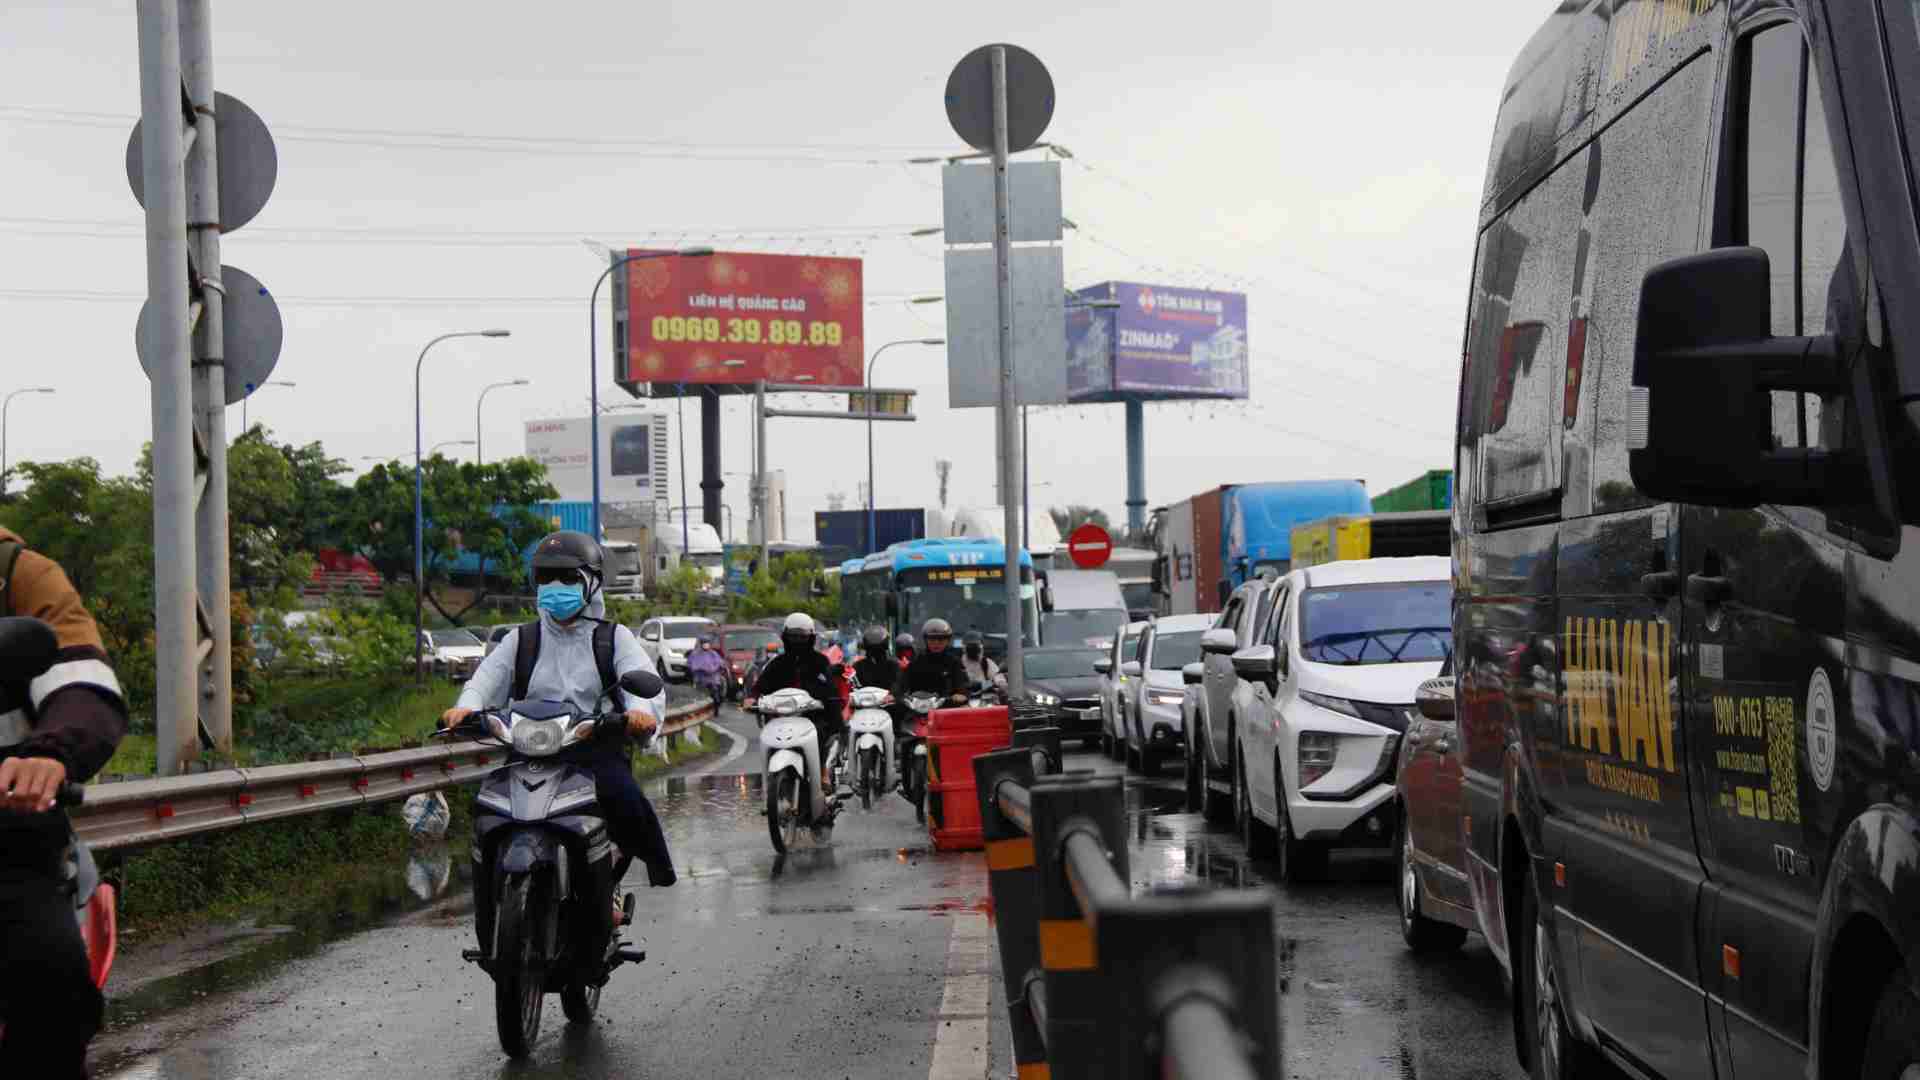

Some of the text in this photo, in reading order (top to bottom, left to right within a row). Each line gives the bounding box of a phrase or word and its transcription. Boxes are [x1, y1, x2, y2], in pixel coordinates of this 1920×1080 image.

[688, 293, 716, 308] LIÊN
[718, 294, 735, 310] HỆ
[651, 316, 842, 347] 0969.39.89.89
